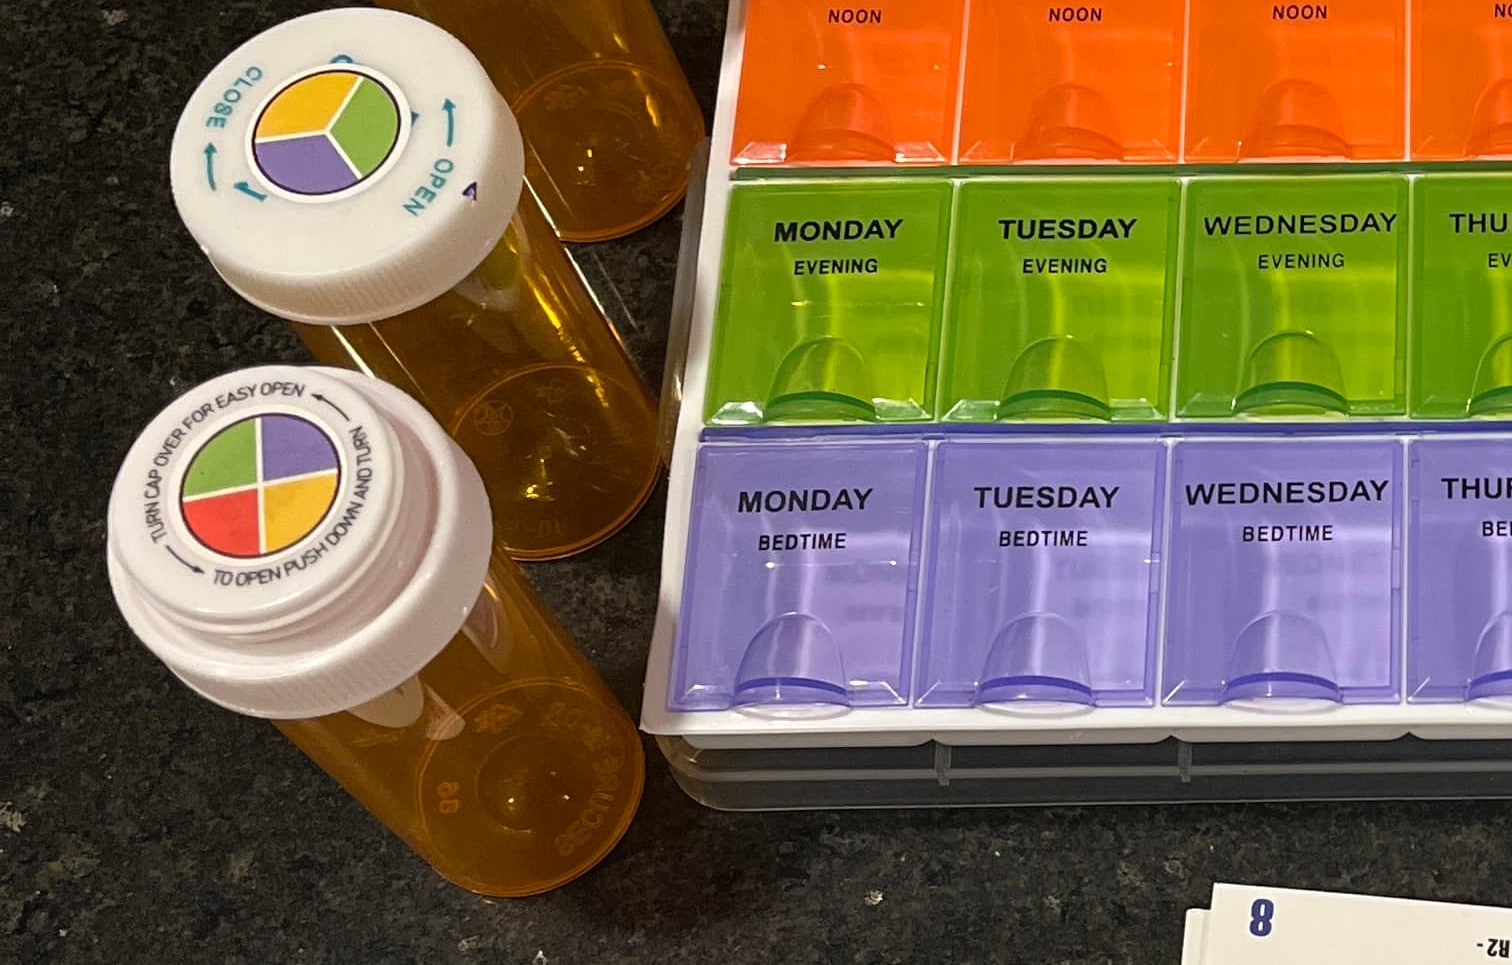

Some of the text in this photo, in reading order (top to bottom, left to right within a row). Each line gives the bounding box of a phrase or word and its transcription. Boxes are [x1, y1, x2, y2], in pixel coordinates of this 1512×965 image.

[828, 9, 881, 24] NOON
[1049, 7, 1102, 22] NOON
[1273, 5, 1327, 20] NOON
[205, 66, 264, 129] CLOSE
[402, 157, 455, 217] OPEN
[774, 218, 904, 243] MONDAY
[998, 218, 1138, 240] TUESDAY
[1204, 212, 1397, 236] WEDNESDAY
[794, 258, 878, 276] EVENING
[1022, 258, 1107, 274] EVENING
[1258, 252, 1345, 270] EVENING
[144, 381, 306, 544] TURN CAP OVER FOR EASY OPEN
[737, 488, 873, 513] MONDAY
[973, 486, 1120, 509] TUESDAY
[1185, 479, 1389, 506] WEDNESDAY
[214, 425, 373, 587] TO OPEN PUSH DOWN AND TURN
[758, 533, 846, 551] BEDTIME
[999, 530, 1088, 547] BEDTIME
[1242, 525, 1333, 542] BEDTIME
[1249, 898, 1275, 936] 8
[1487, 938, 1510, 958] R2
